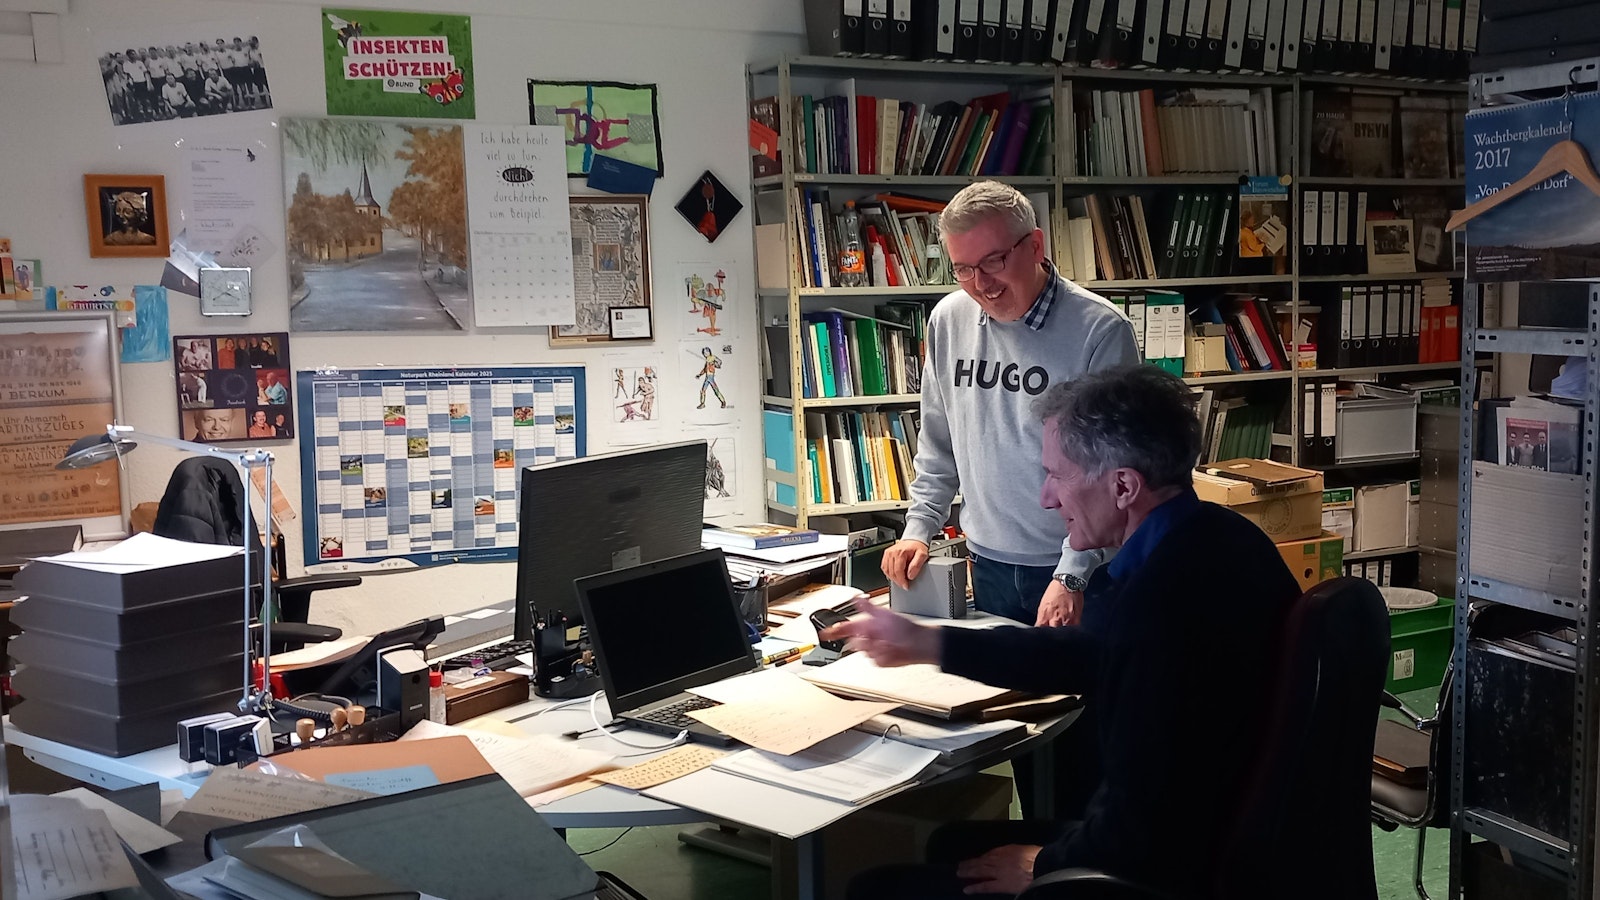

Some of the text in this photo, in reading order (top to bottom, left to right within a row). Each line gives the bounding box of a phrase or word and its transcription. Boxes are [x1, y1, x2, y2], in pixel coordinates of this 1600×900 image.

[353, 39, 444, 55] INSEKTEN
[348, 59, 453, 78] SCHÜTZEN!
[480, 132, 549, 145] Ich habe heute
[486, 150, 501, 161] viel
[1474, 147, 1511, 170] 2017
[504, 169, 529, 182] Nicht
[1543, 175, 1574, 190] Dorf“
[493, 191, 549, 203] durchdrehen
[510, 207, 545, 224] Beispiel.
[400, 371, 427, 379] Naturpark
[954, 359, 1050, 395] HUGO
